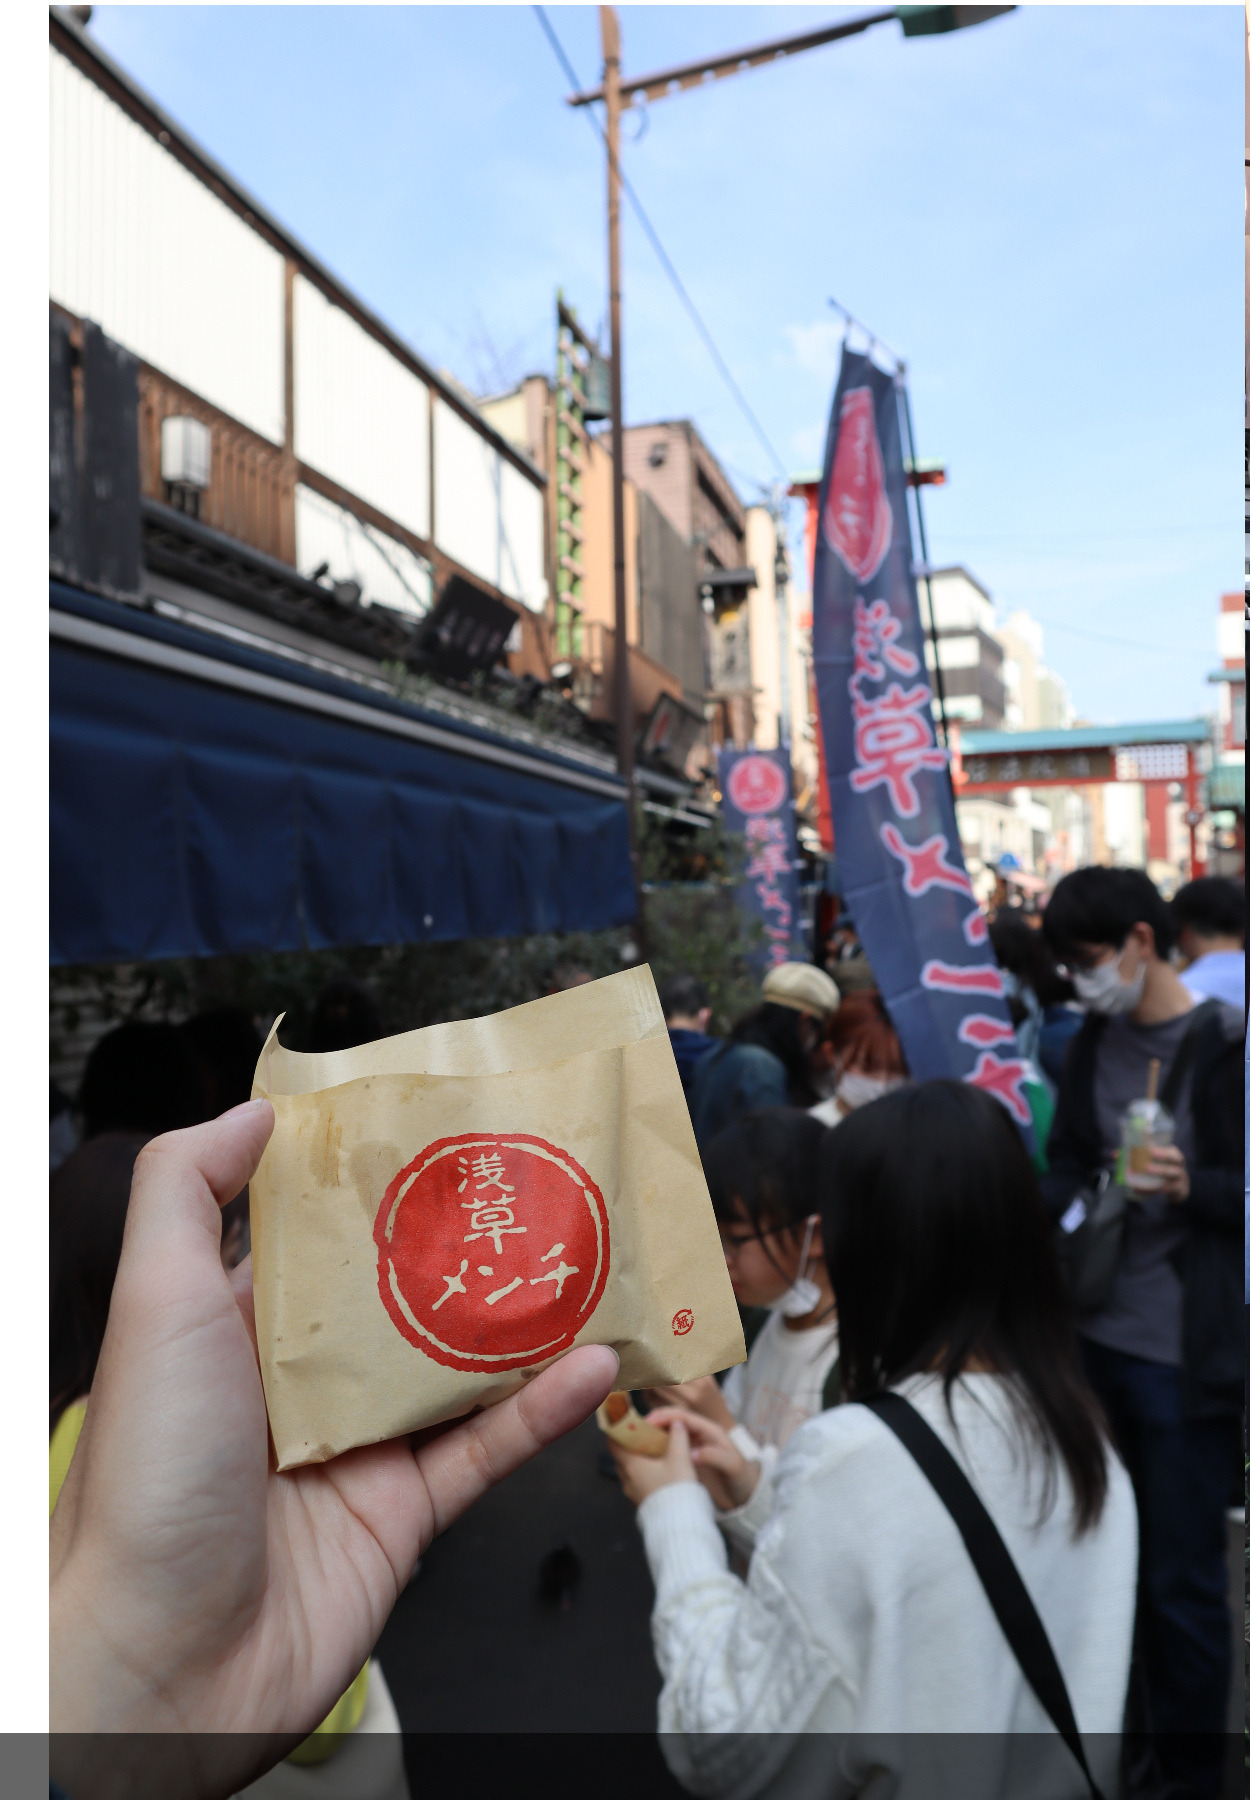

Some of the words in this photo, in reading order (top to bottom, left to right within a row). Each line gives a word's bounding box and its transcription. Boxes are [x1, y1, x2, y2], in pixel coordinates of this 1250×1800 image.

[457, 1152, 528, 1255] 浅草
[431, 1241, 580, 1312] メンチ
[674, 1315, 691, 1331] 紙
